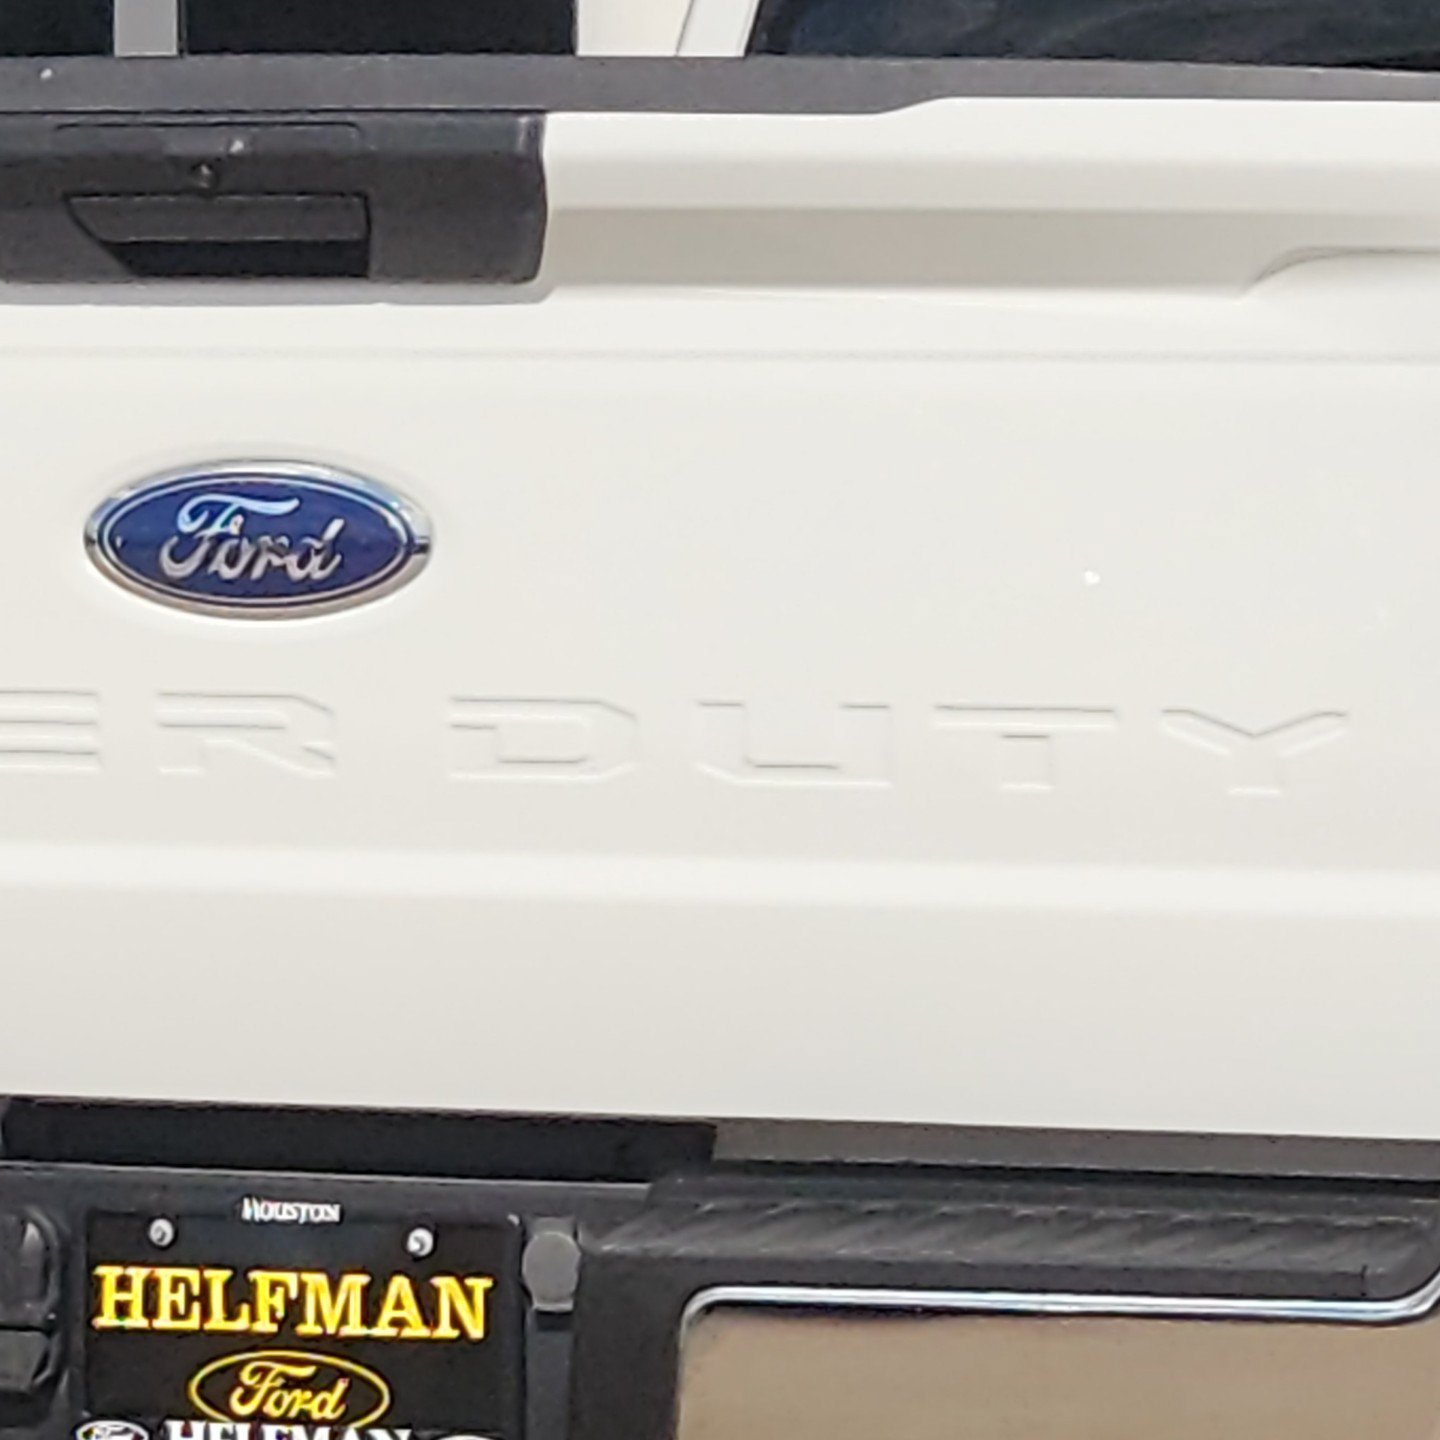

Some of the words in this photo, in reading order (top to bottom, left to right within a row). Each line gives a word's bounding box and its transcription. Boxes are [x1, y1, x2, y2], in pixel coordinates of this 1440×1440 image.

[160, 493, 346, 581] Ford
[448, 694, 1350, 798] DUTY
[92, 1264, 494, 1340] HELFMAN
[228, 1360, 350, 1421] Ford
